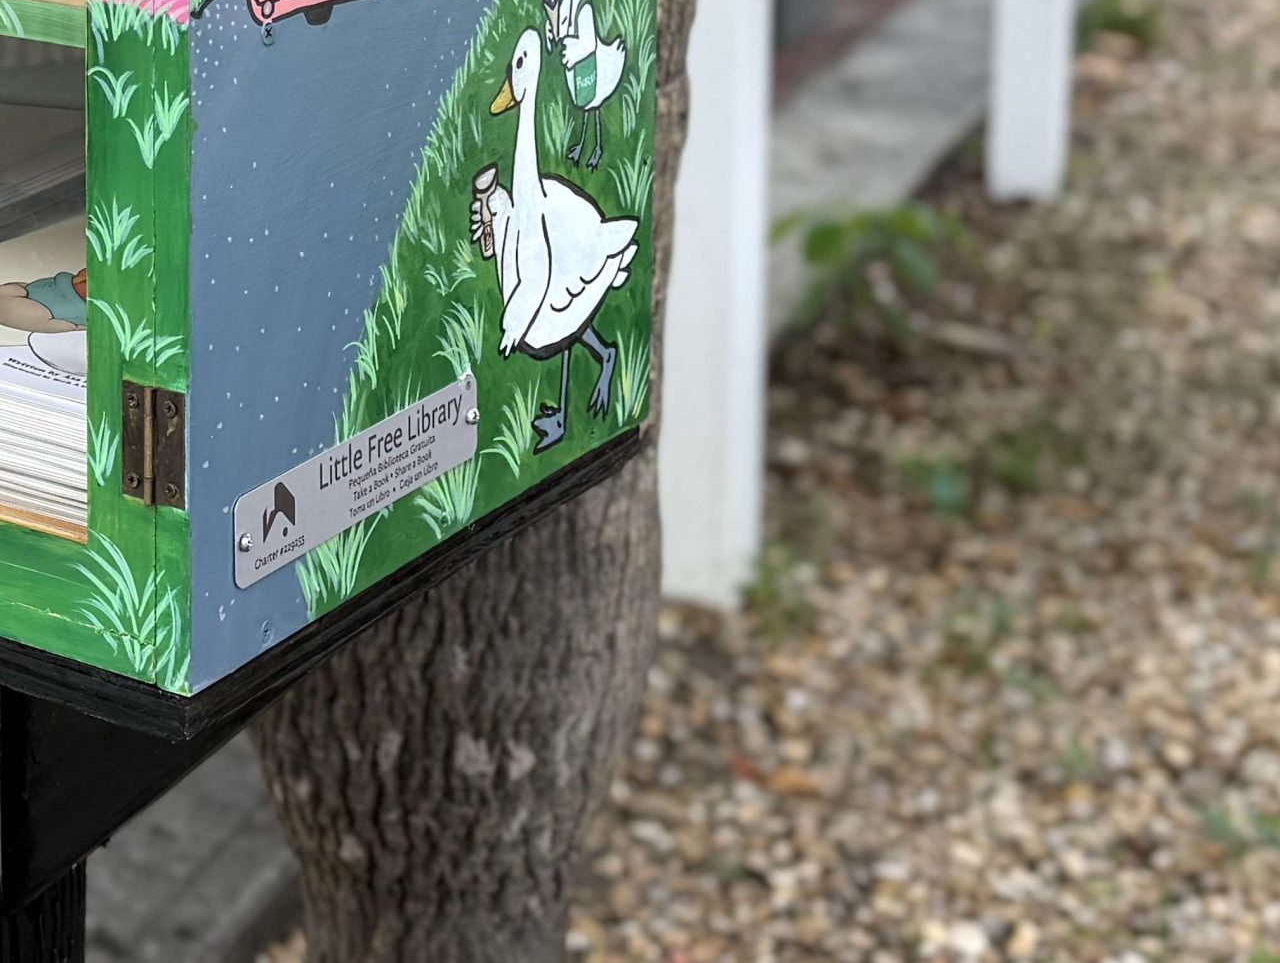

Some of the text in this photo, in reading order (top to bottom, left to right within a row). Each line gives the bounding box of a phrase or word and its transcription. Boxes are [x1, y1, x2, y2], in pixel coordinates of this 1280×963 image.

[319, 394, 462, 490] Little Free Library
[377, 449, 409, 474] Biblioteca
[409, 435, 436, 455] Gratuita
[349, 461, 439, 518] Toma un Libro Deja un Libro
[353, 488, 368, 502] Take
[373, 474, 390, 491] Book
[394, 463, 411, 479] Share
[417, 449, 433, 468] Book
[254, 549, 279, 570] Charter
